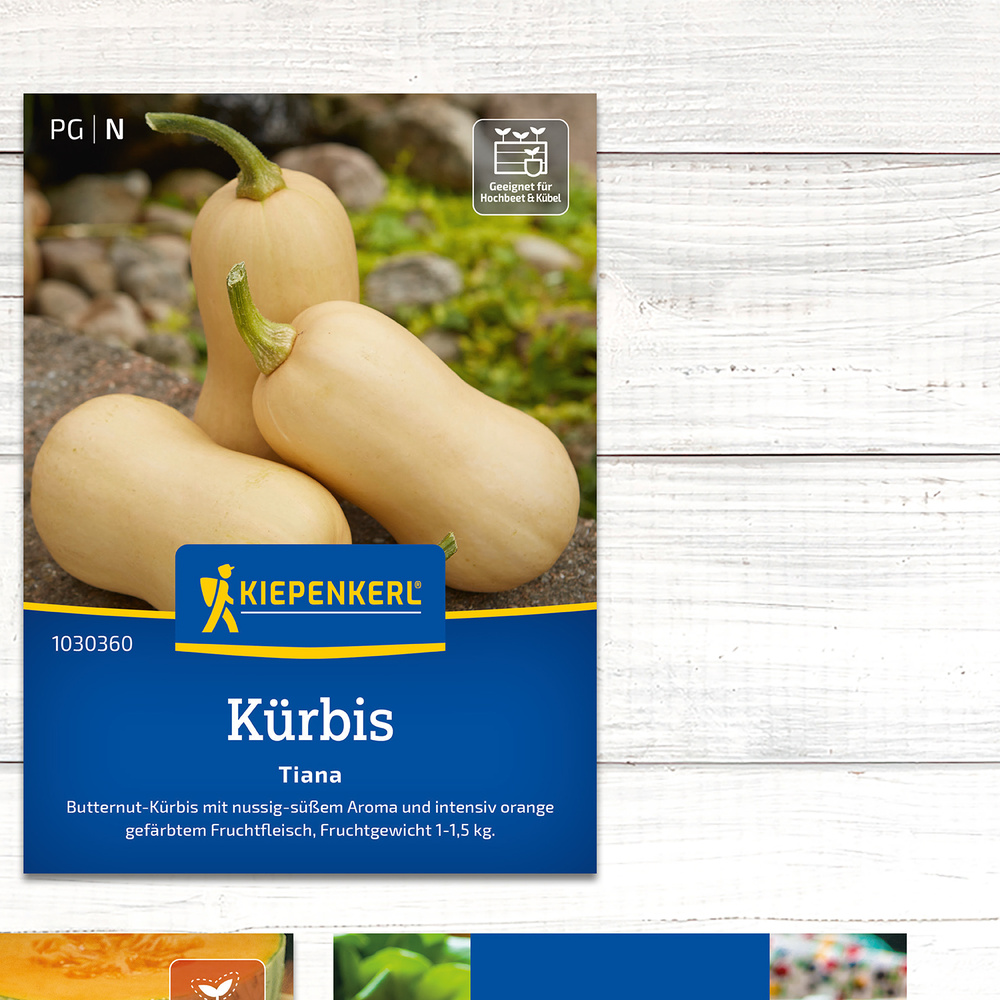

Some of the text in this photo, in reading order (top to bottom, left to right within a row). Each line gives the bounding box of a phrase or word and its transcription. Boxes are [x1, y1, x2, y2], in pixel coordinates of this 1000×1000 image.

[50, 118, 125, 141] PG N
[489, 181, 553, 193] Geeignet für
[480, 193, 562, 203] Hochbeet & Kübel
[51, 635, 133, 652] 1030360
[227, 696, 394, 742] Kürbis
[278, 765, 342, 784] Tiana
[67, 799, 555, 817] Butternut-Kürbis mit nussig-süßem Aroma und intensiv orange
[125, 822, 495, 840] gefärbtem Fruchtfleisch, Fruchtgewicht 1-1,5 kg.
